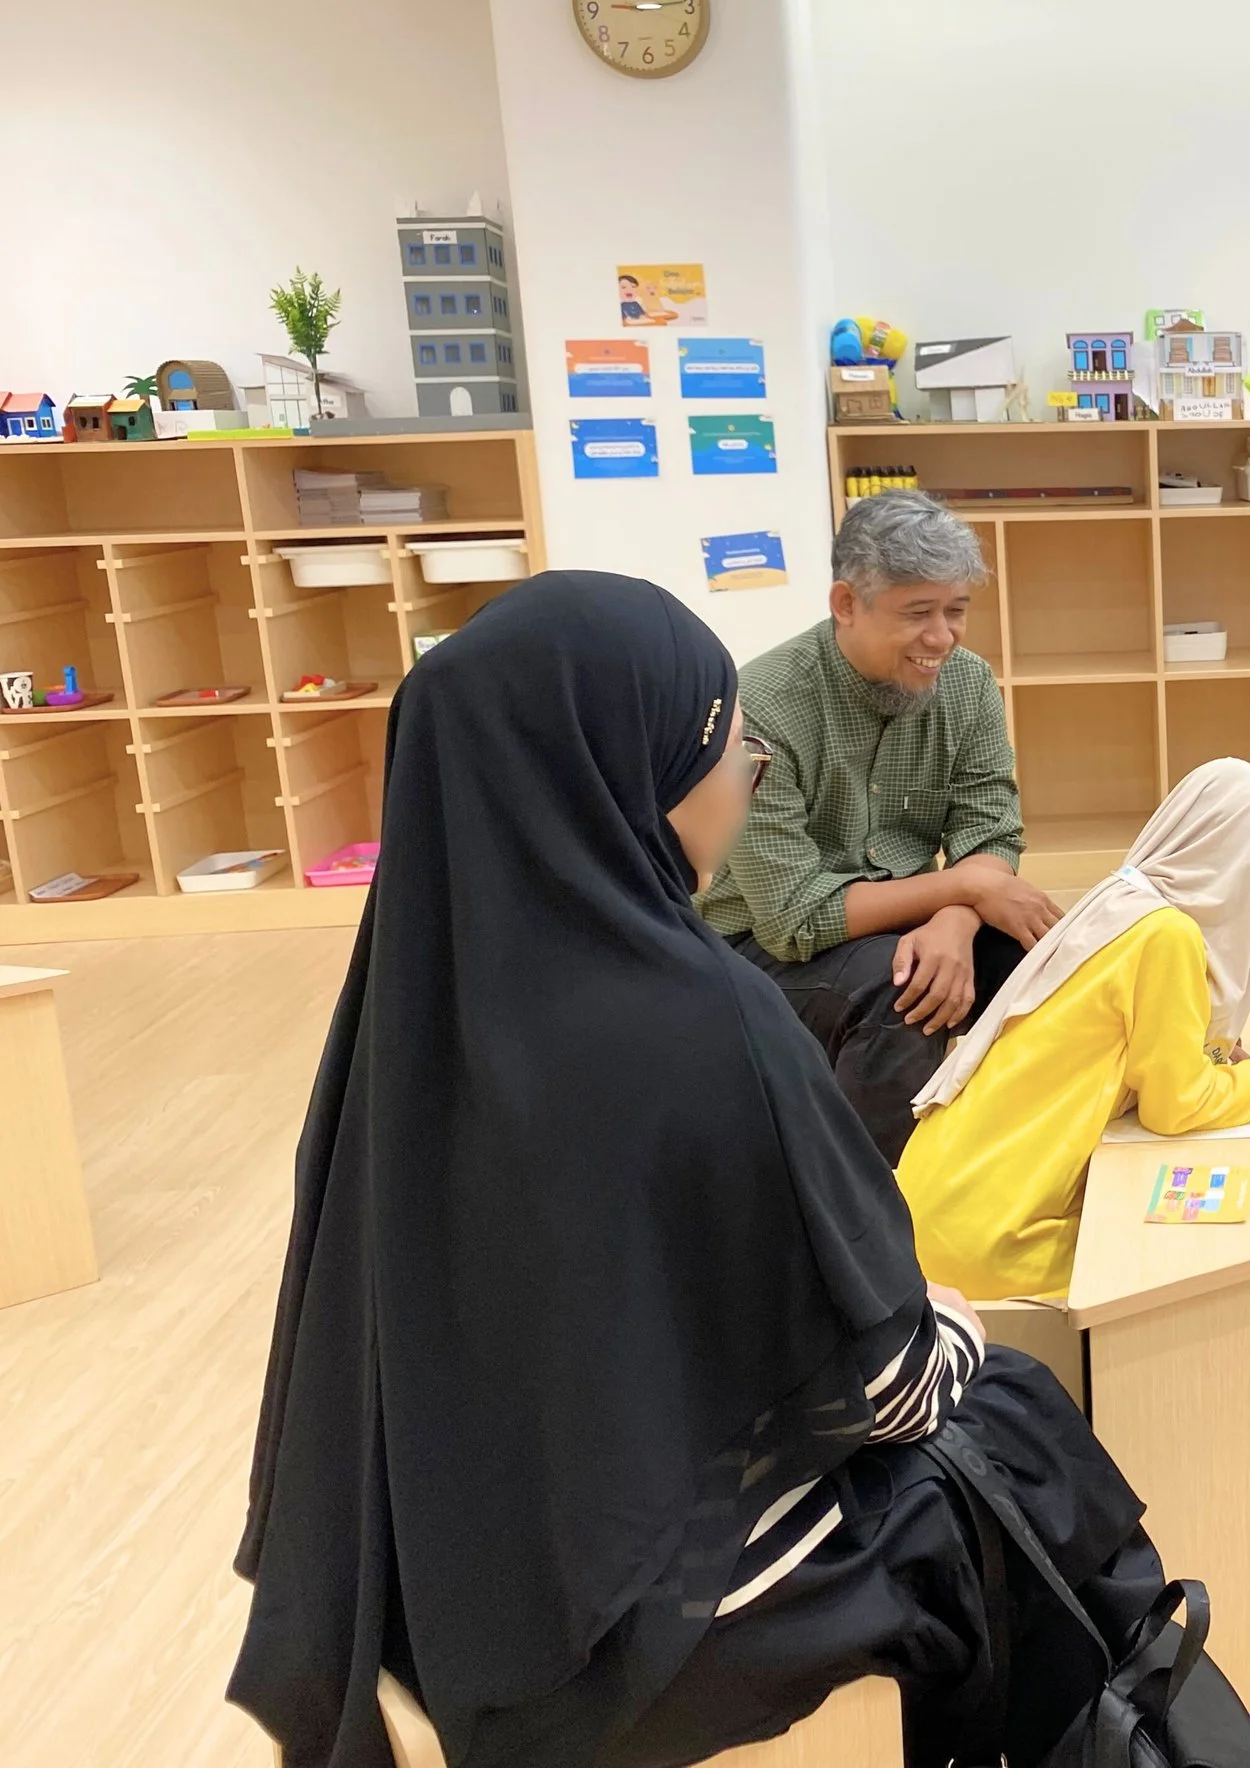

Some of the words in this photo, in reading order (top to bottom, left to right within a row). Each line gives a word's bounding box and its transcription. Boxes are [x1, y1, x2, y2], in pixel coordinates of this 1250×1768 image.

[586, 1, 600, 20] 9
[684, 0, 695, 15] 3
[598, 25, 610, 43] 8
[678, 22, 691, 38] 4
[617, 41, 629, 58] 7
[641, 46, 655, 65] 6
[664, 39, 676, 57] 5
